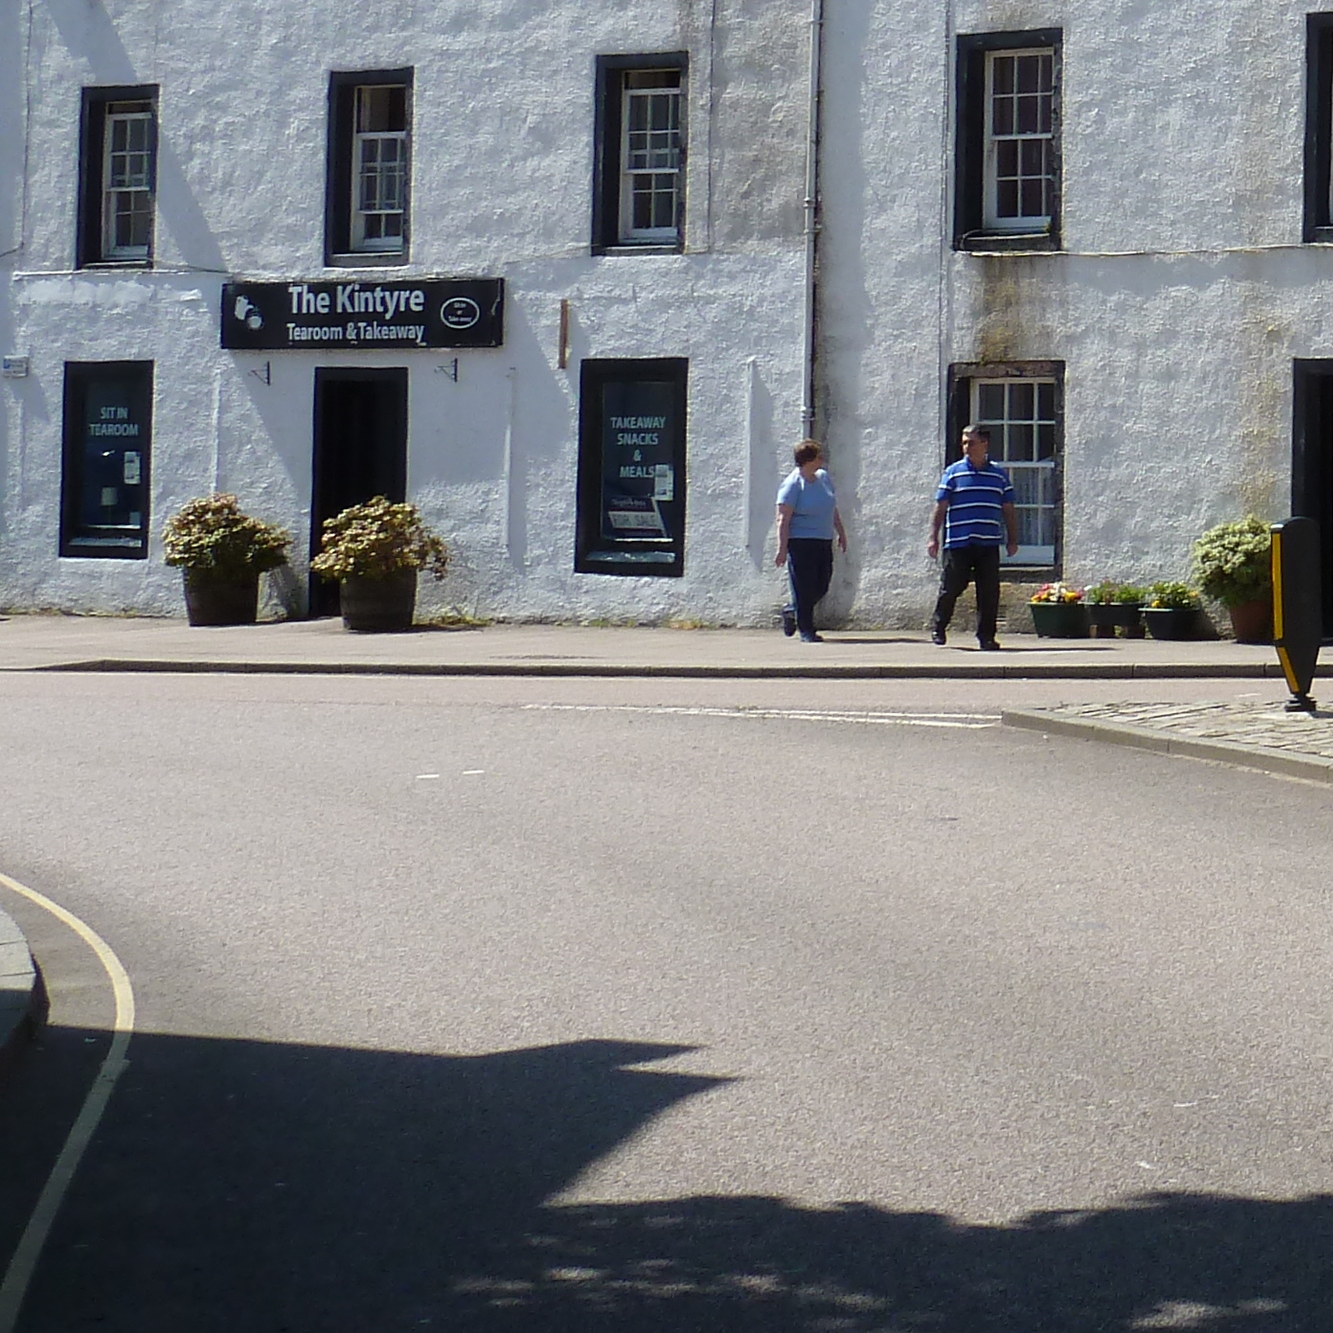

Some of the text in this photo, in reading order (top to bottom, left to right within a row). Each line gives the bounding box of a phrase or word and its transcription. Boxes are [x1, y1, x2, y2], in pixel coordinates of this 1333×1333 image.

[288, 283, 425, 320] The Kintyre
[286, 321, 425, 343] Tearoom & Takeaway
[100, 407, 128, 419] SIT IN
[610, 416, 666, 428] TAKEAWAY
[90, 424, 138, 436] TEAROOM
[617, 433, 659, 445] SNACKS
[633, 449, 642, 462] &
[619, 466, 655, 478] MEALS
